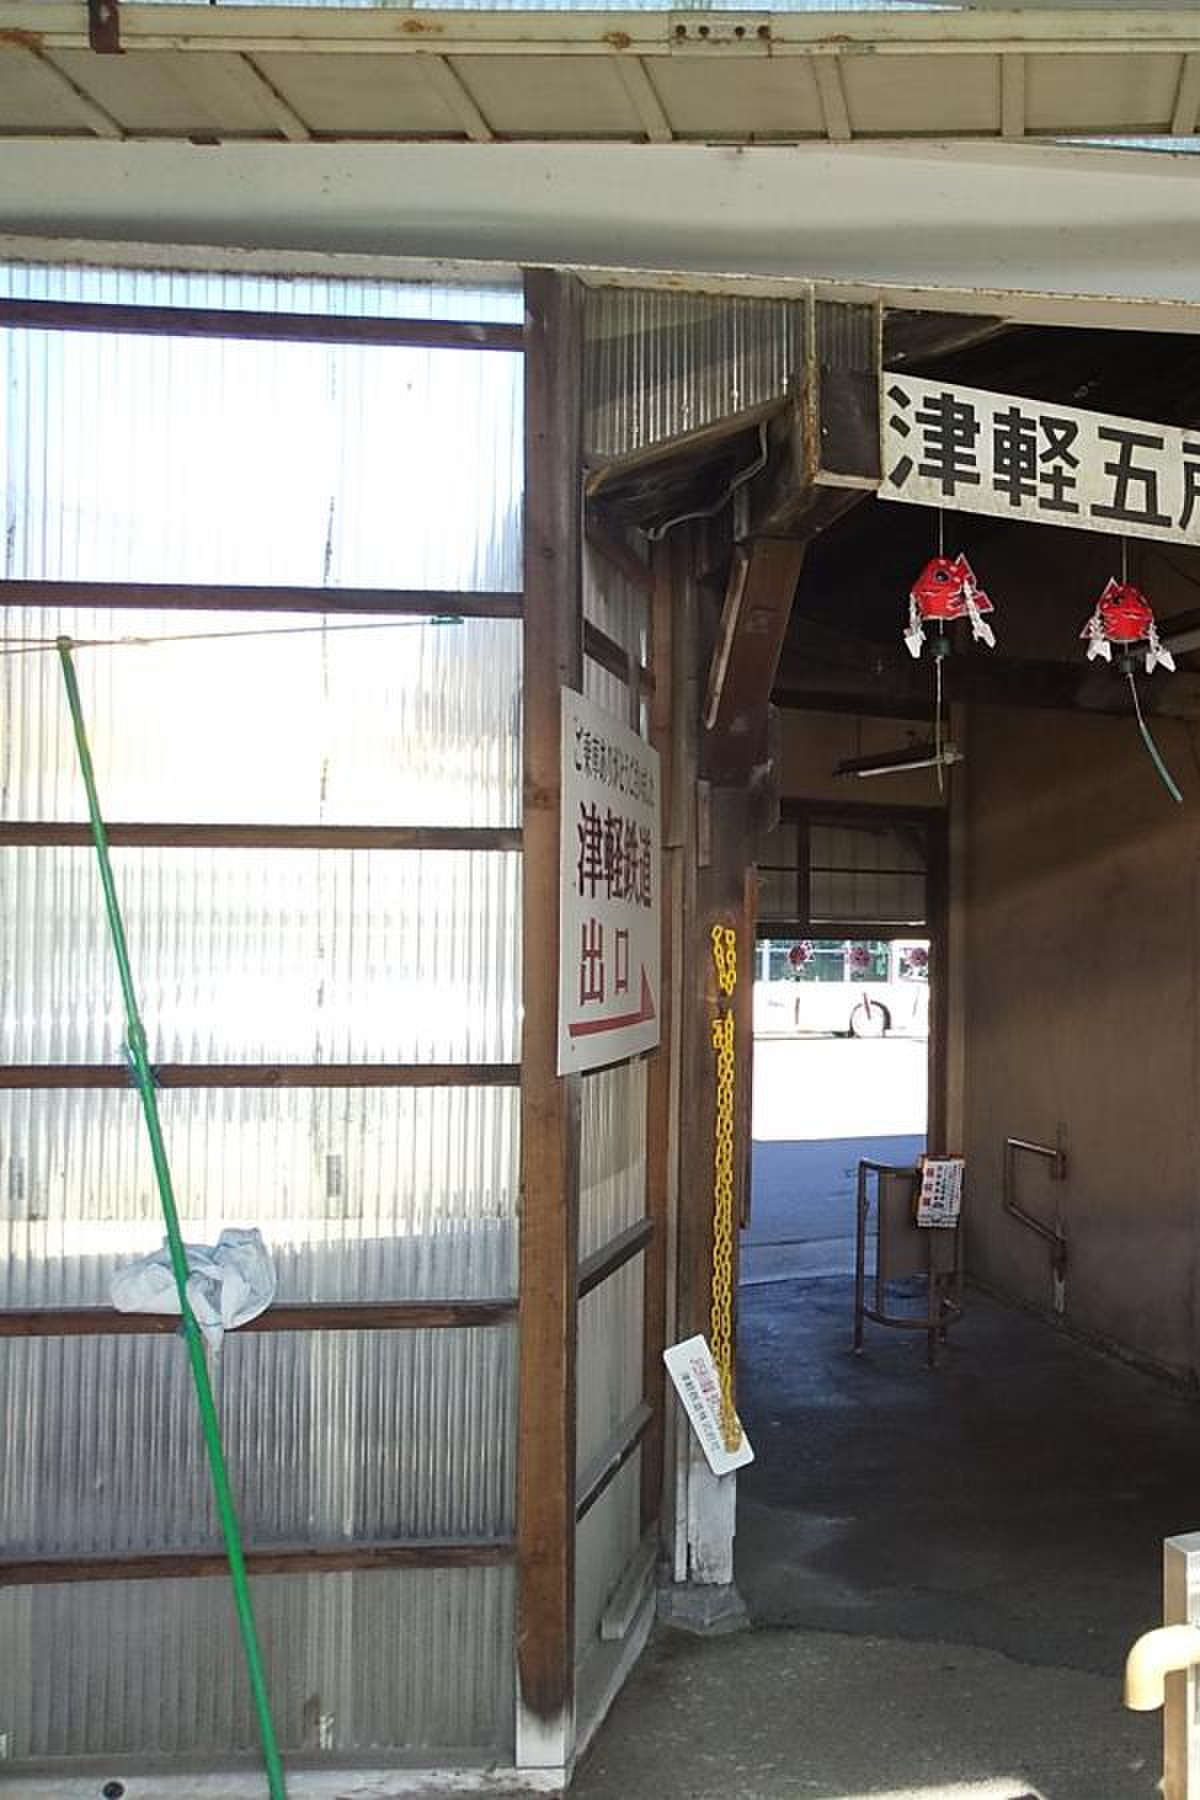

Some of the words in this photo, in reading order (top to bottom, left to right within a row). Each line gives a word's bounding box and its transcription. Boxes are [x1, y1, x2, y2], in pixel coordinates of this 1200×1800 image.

[577, 801, 652, 908] 津軽鉄道
[580, 917, 629, 1007] 出口
